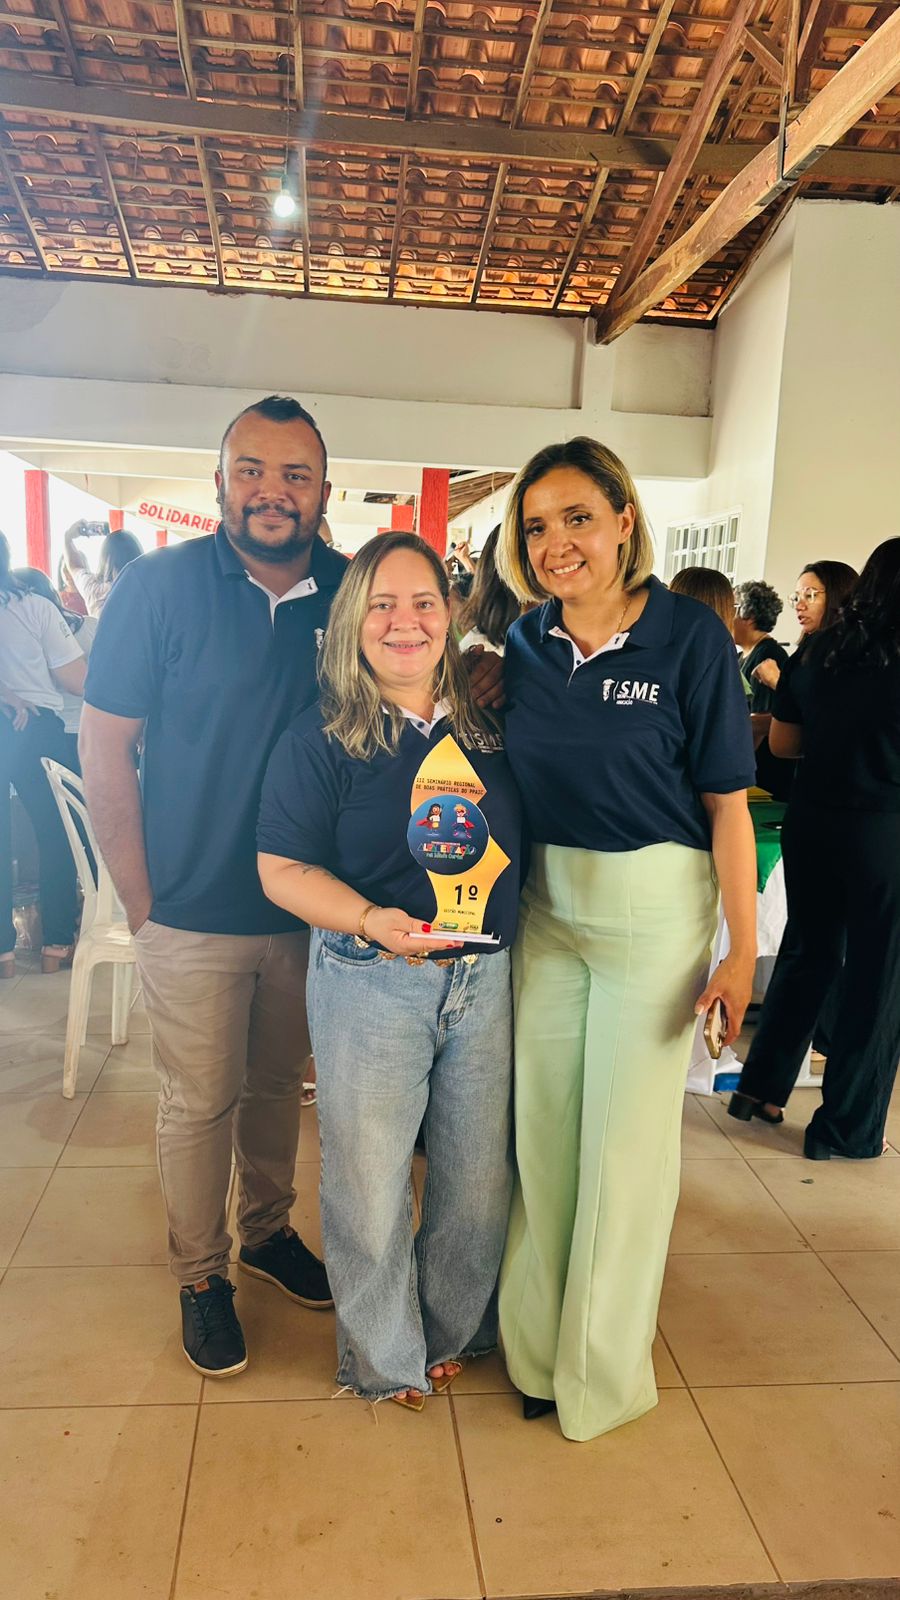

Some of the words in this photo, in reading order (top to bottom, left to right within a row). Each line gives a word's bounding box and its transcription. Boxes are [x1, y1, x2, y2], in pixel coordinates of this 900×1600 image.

[620, 680, 660, 702] SME
[454, 780, 476, 788] REGIONAL
[437, 785, 460, 793] PRÁTICAS
